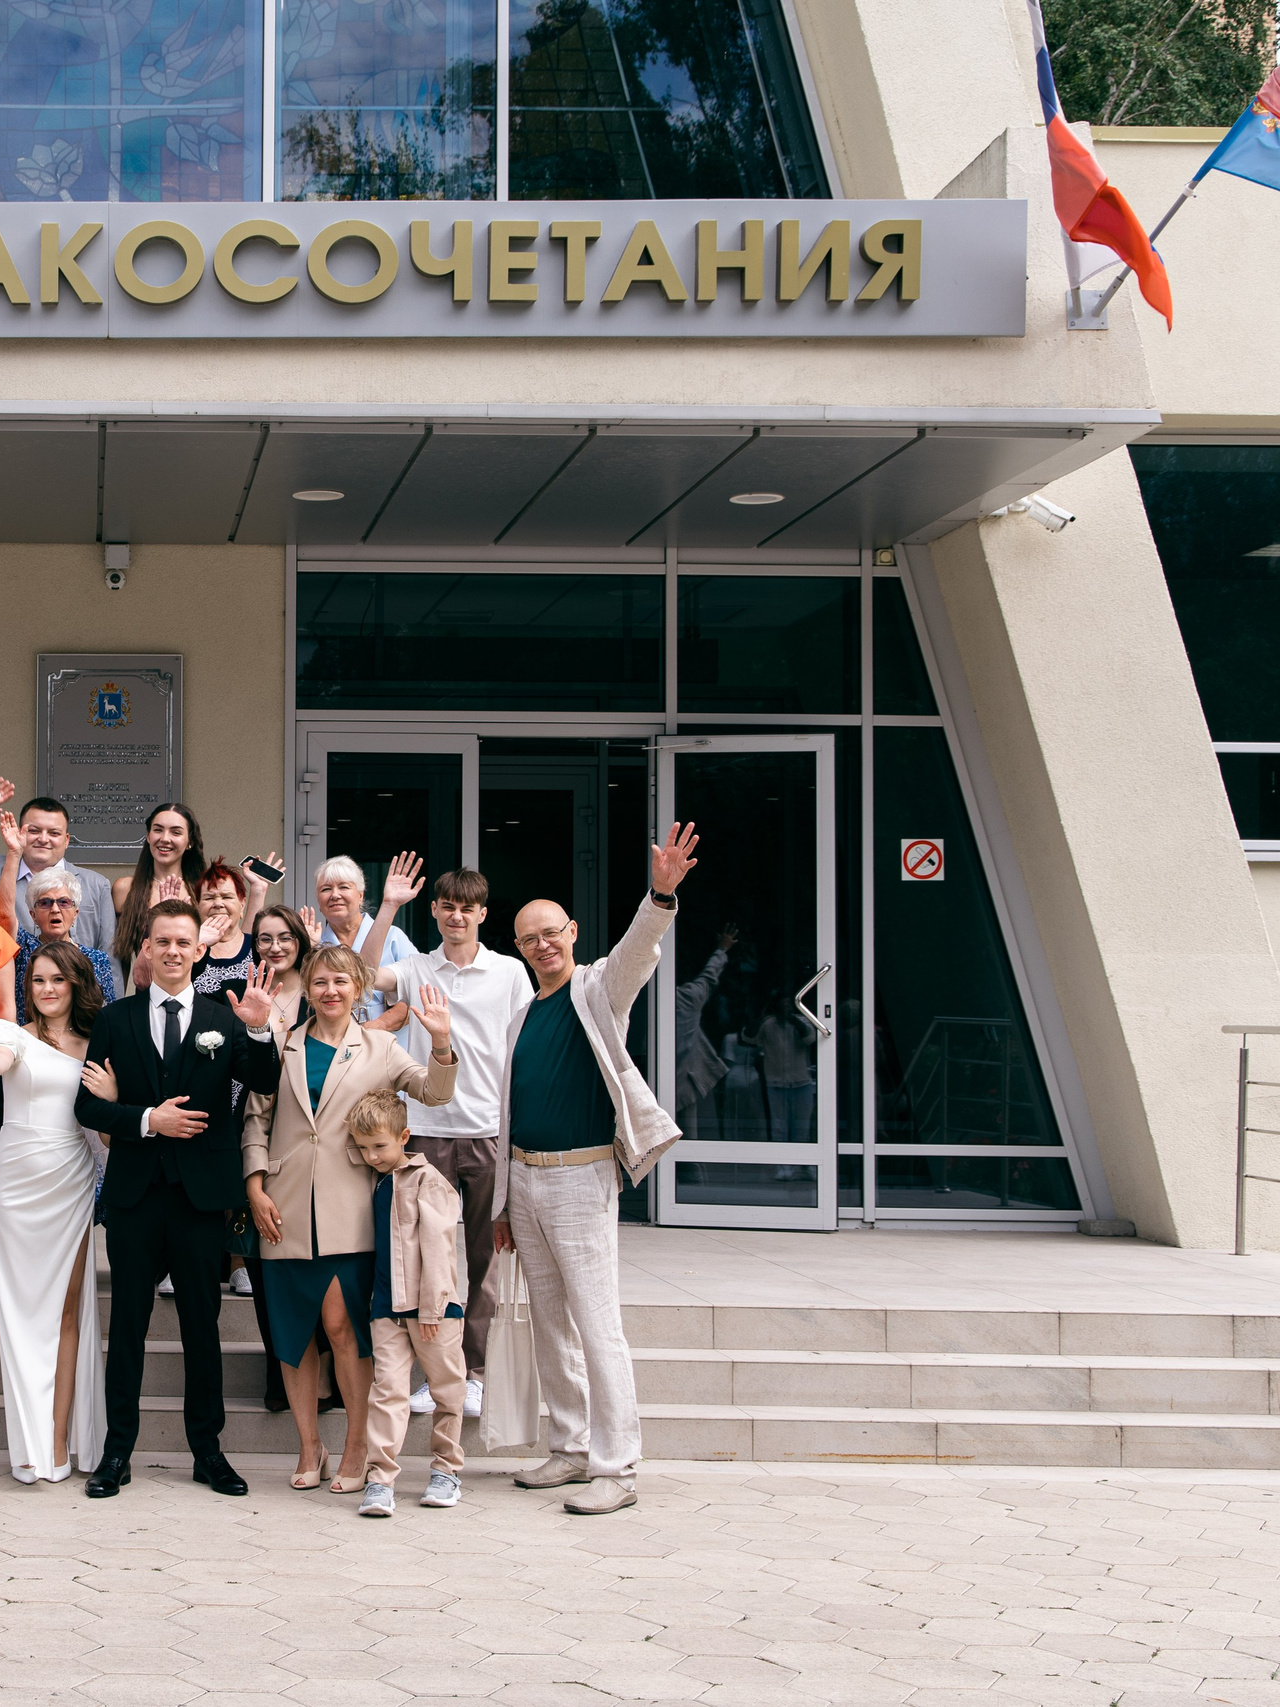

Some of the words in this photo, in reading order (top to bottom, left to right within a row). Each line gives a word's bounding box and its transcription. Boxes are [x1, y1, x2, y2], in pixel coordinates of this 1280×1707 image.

[88, 783, 130, 792] ДВОРЕЦ
[59, 794, 159, 803] БРАКОСОЧЕТАНИЯ
[73, 805, 145, 814] ГОРОДСКОГО
